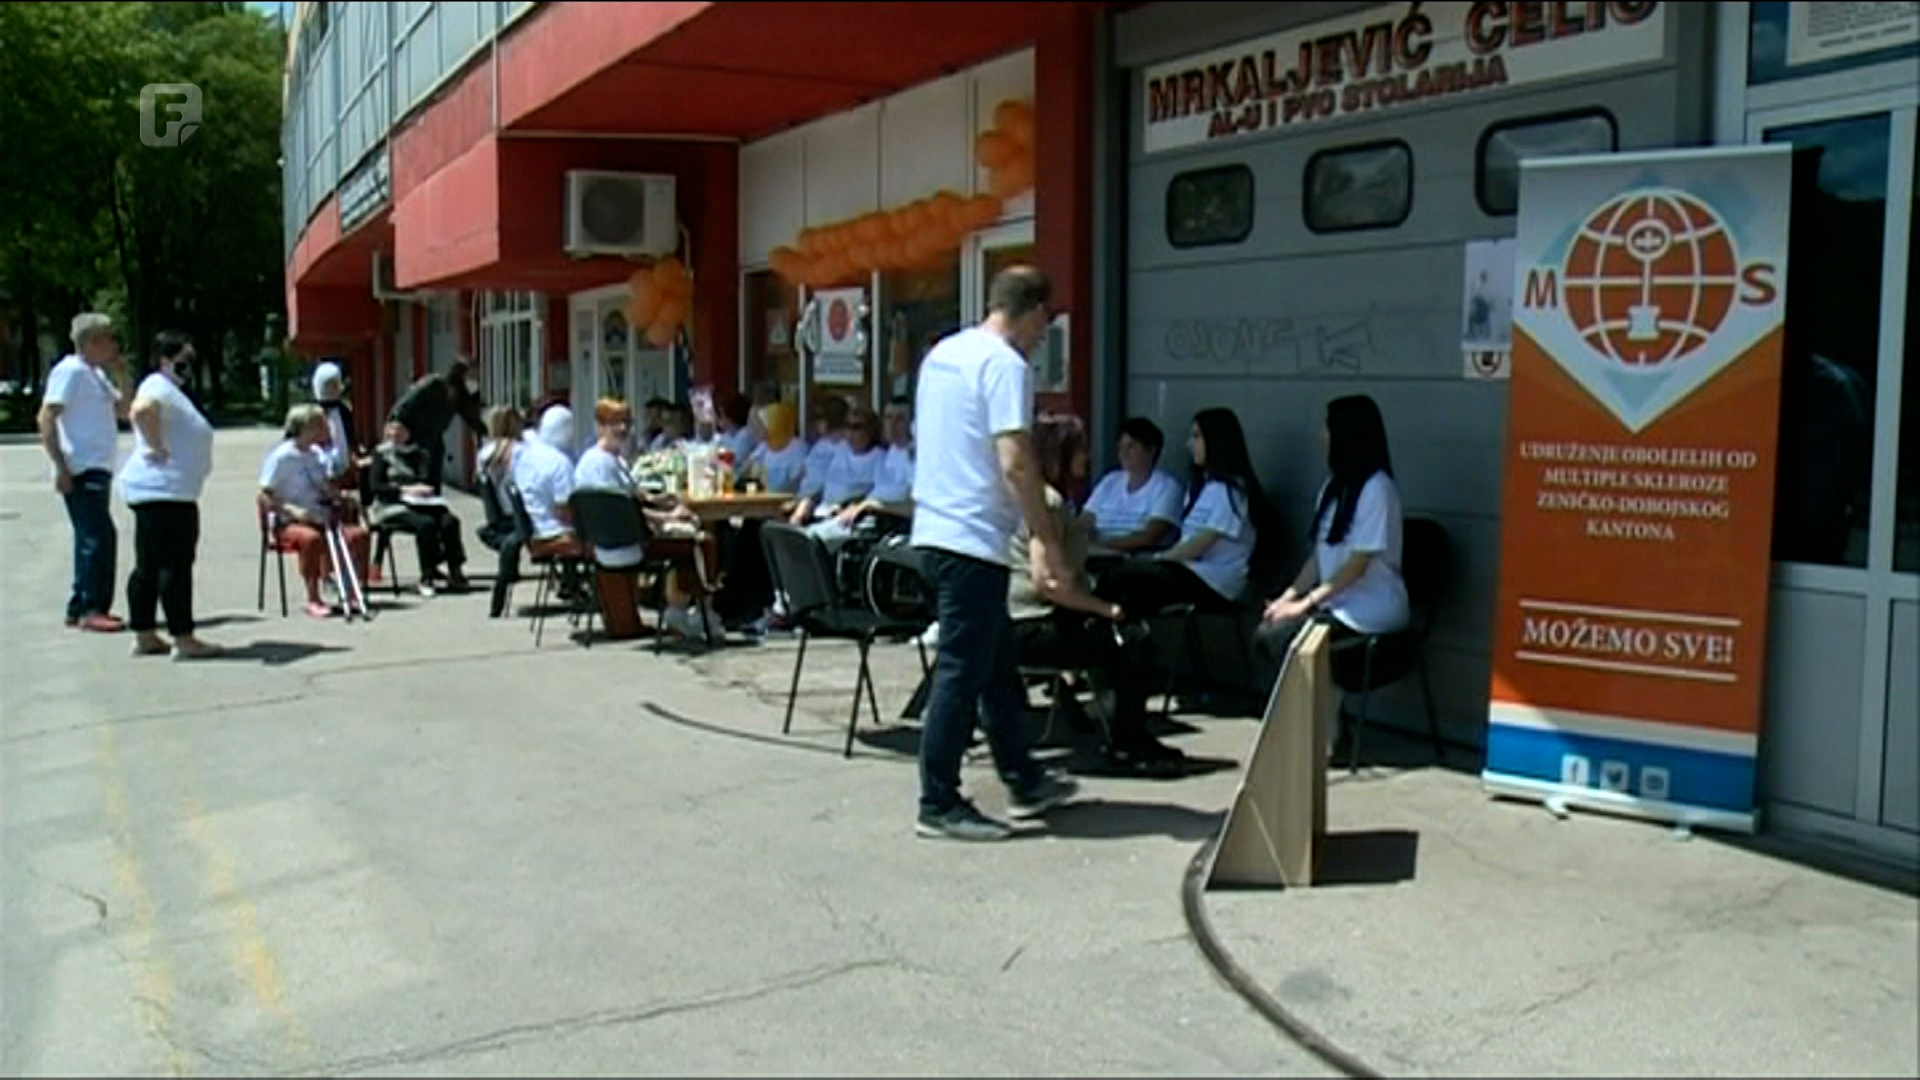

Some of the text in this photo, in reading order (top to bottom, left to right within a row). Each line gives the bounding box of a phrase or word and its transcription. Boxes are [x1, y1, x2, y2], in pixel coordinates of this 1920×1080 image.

[1149, 6, 1434, 122] MRKALJEVIĆ
[1341, 54, 1508, 113] STOLARIJA
[1524, 263, 1778, 309] M S
[1519, 441, 1757, 469] UDRUŽENJE OBOLJELIH OD
[1542, 467, 1730, 493] MULTIPLE SKLEROZE
[1585, 518, 1676, 541] KANTONA
[1522, 616, 1734, 664] MOŽEMO SVE!
